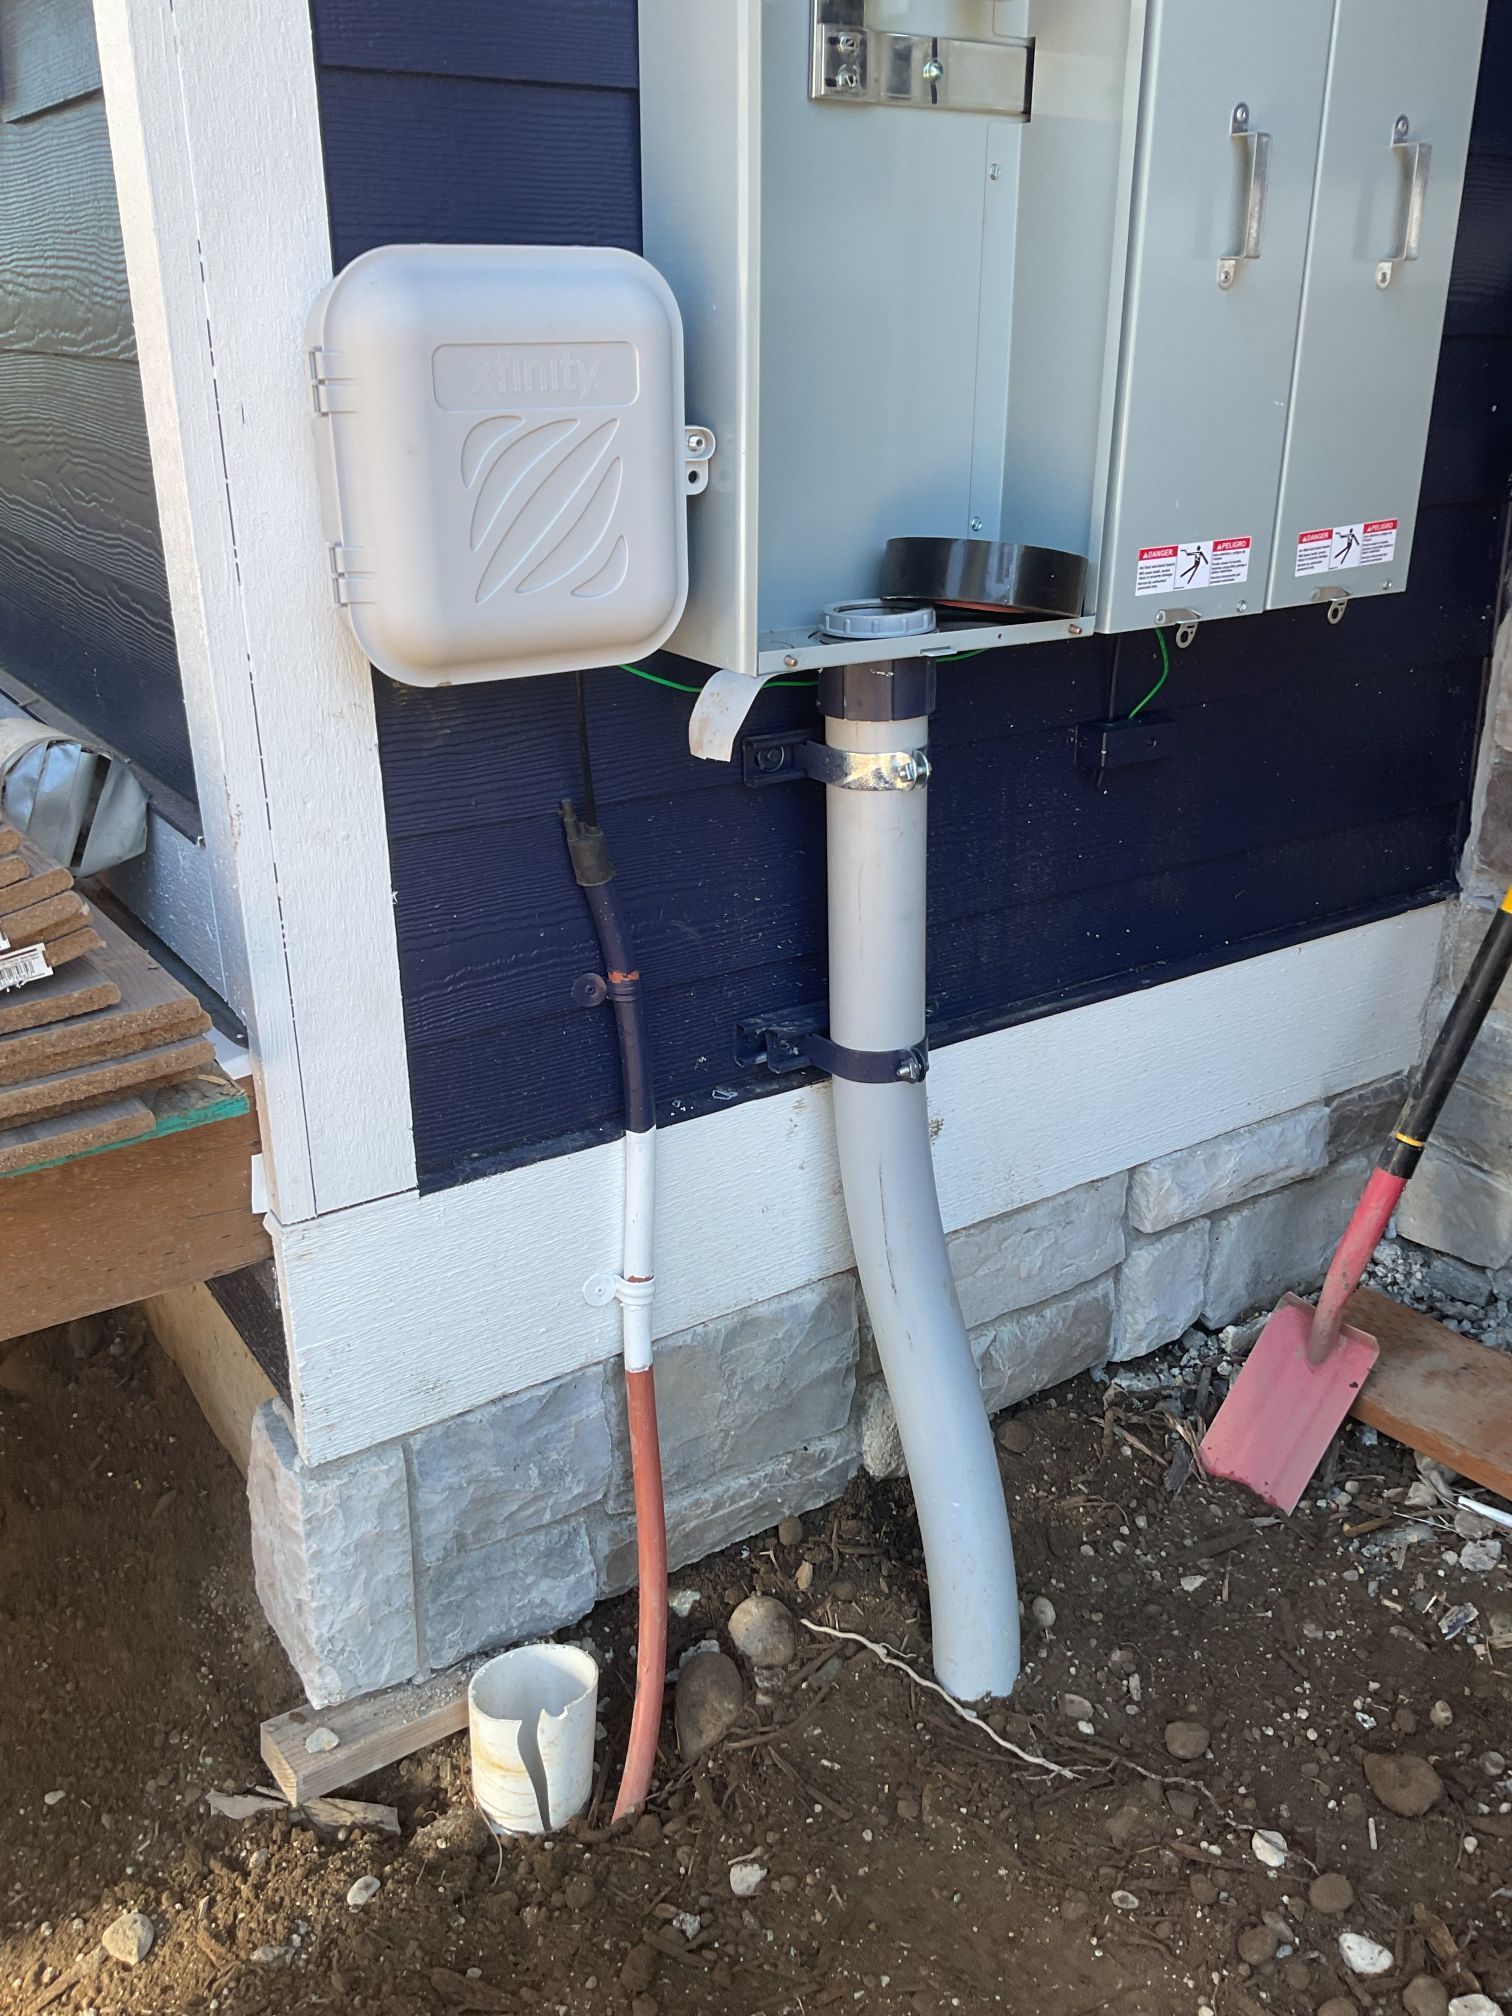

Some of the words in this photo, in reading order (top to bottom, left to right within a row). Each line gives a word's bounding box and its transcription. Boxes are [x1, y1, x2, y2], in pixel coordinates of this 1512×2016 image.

[469, 350, 602, 400] xfinity
[1305, 532, 1329, 541] DANGER
[1221, 540, 1247, 550] PELIGRO
[1148, 548, 1173, 558] DANGER
